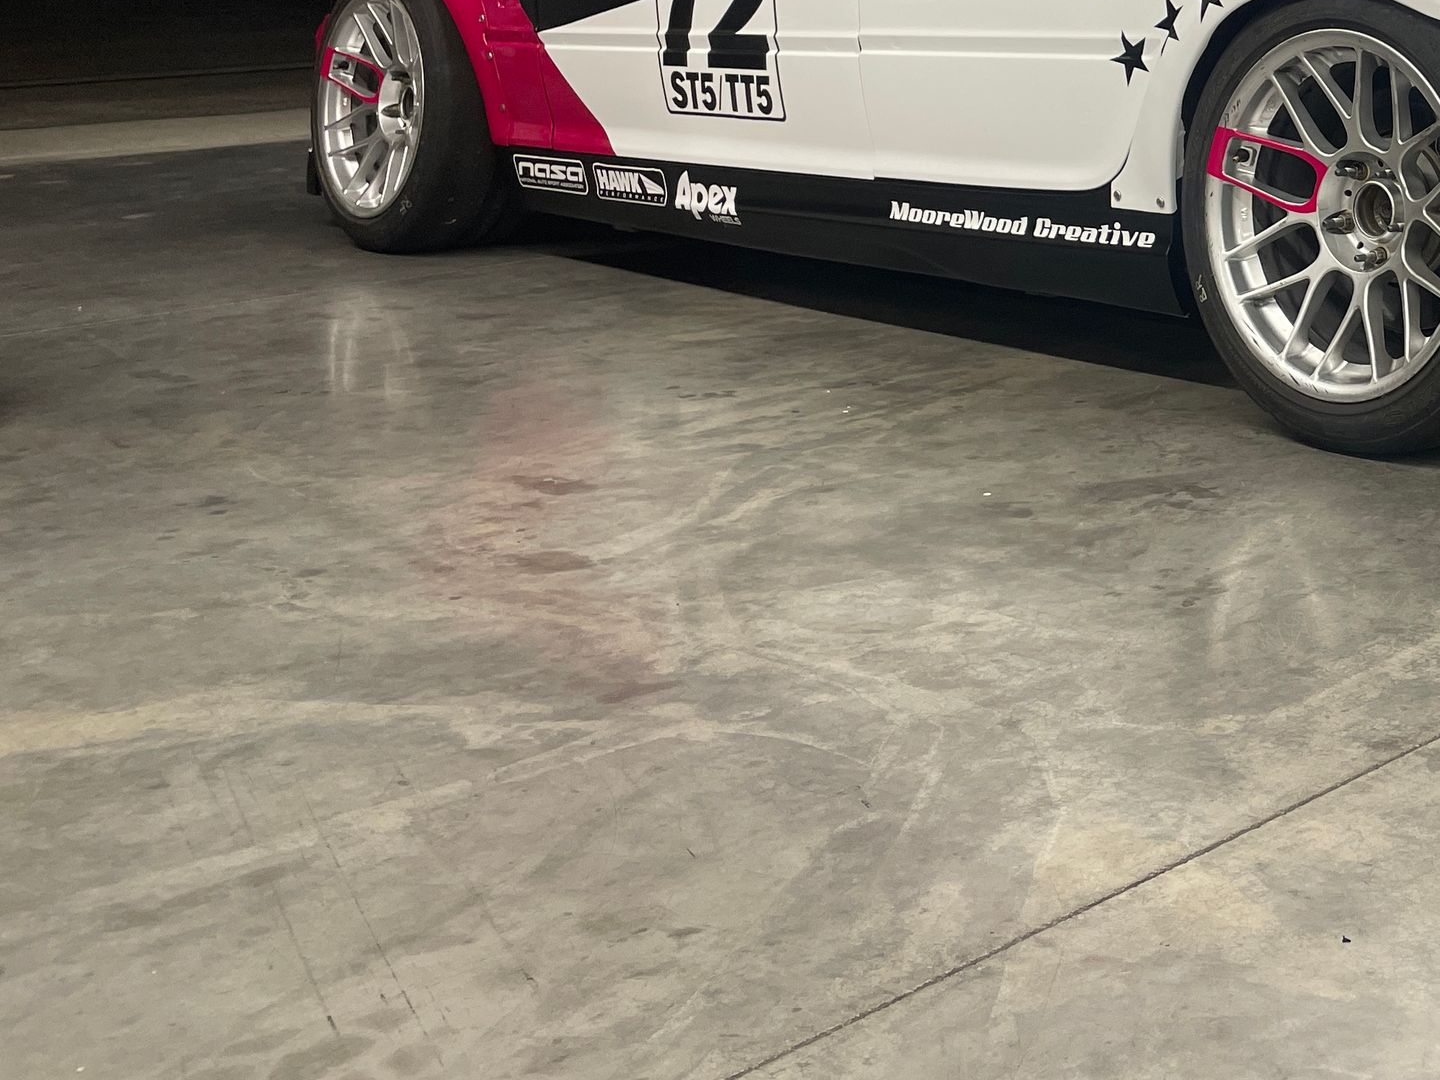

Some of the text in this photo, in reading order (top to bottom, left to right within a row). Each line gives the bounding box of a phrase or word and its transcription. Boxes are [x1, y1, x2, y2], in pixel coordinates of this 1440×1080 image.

[670, 70, 773, 115] ST5/TT5
[596, 168, 643, 194] HAWK
[675, 170, 738, 220] Apex
[889, 200, 1156, 248] MooreWood Creative
